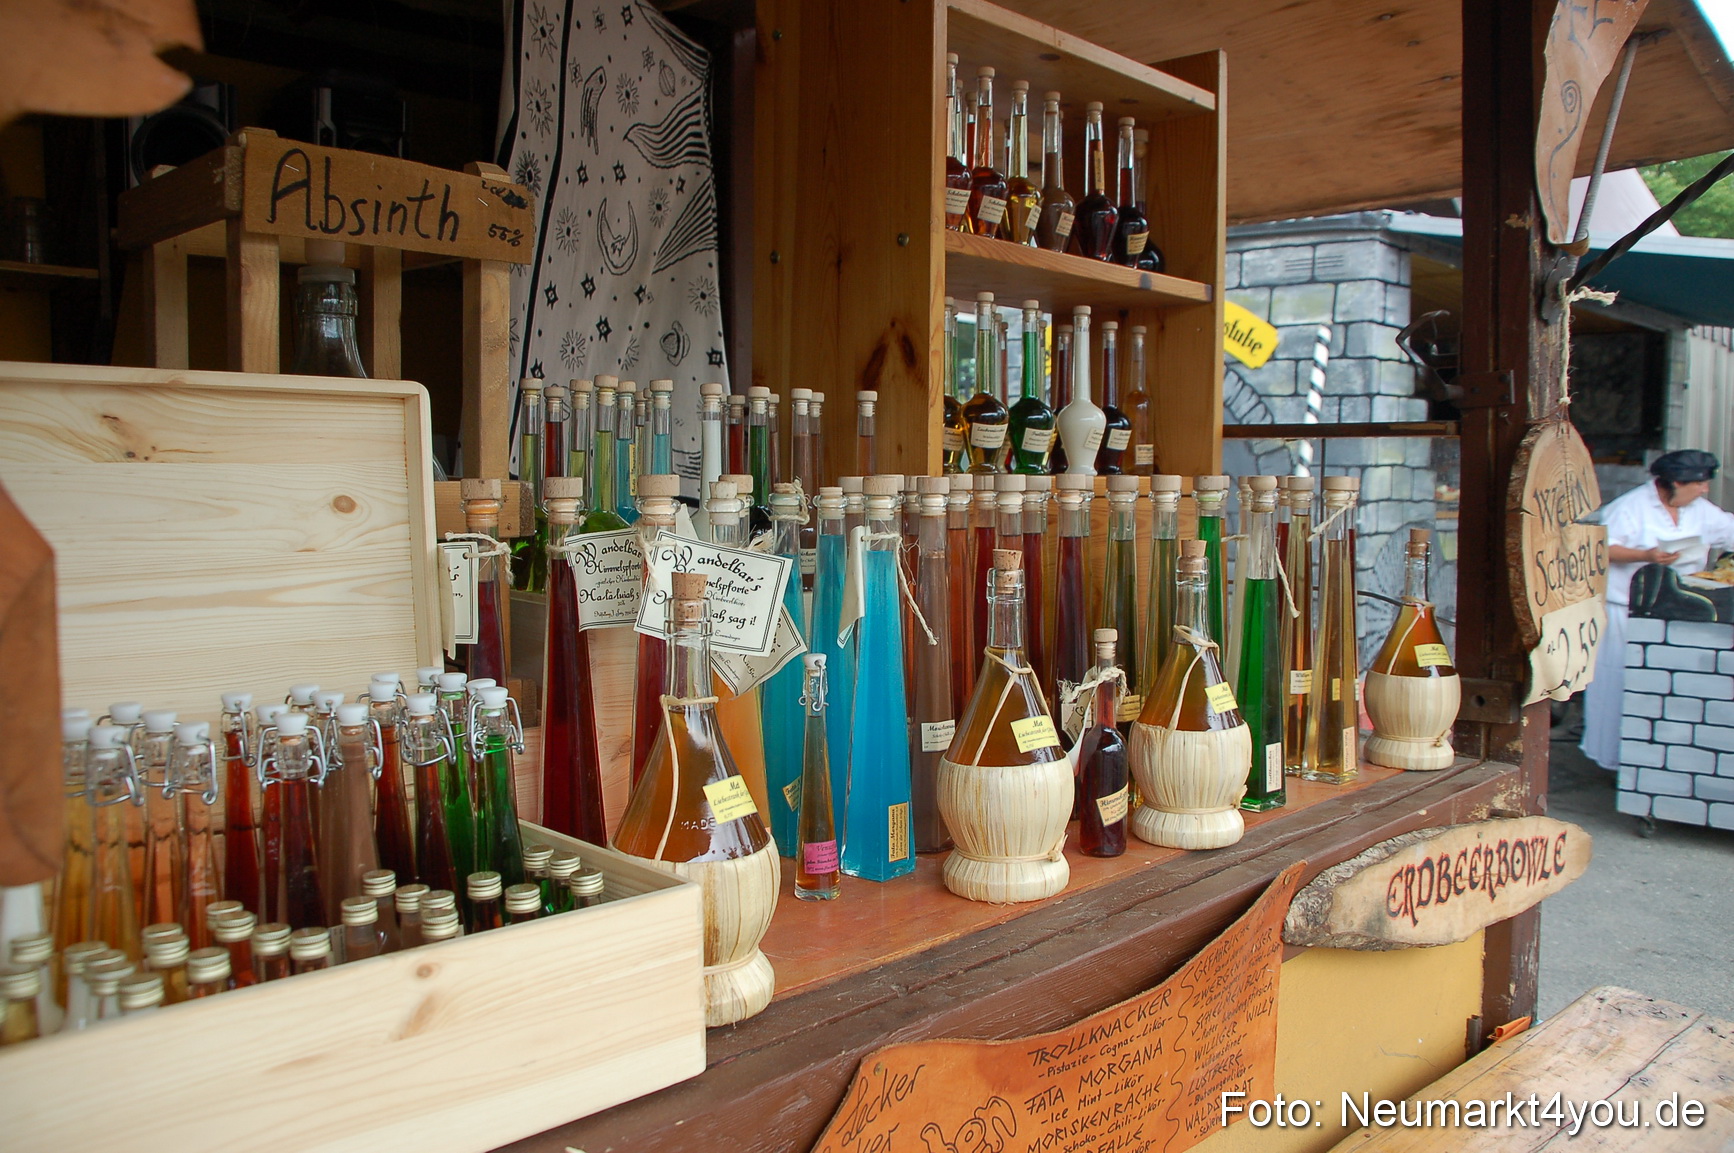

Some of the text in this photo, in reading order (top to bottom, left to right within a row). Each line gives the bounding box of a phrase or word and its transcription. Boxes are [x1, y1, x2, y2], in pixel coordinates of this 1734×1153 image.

[266, 149, 459, 242] Absinth
[488, 224, 524, 247] 55%
[728, 615, 746, 630] sag
[1387, 831, 1568, 928] ERDBEERBOWLE
[1027, 988, 1172, 1067] TROLLKNACKER
[1246, 996, 1274, 1023] WILLY
[836, 1064, 926, 1147] Lecker
[1024, 1038, 1163, 1116] FATA MORGANA
[1027, 1074, 1163, 1153] MORISKENRACHE
